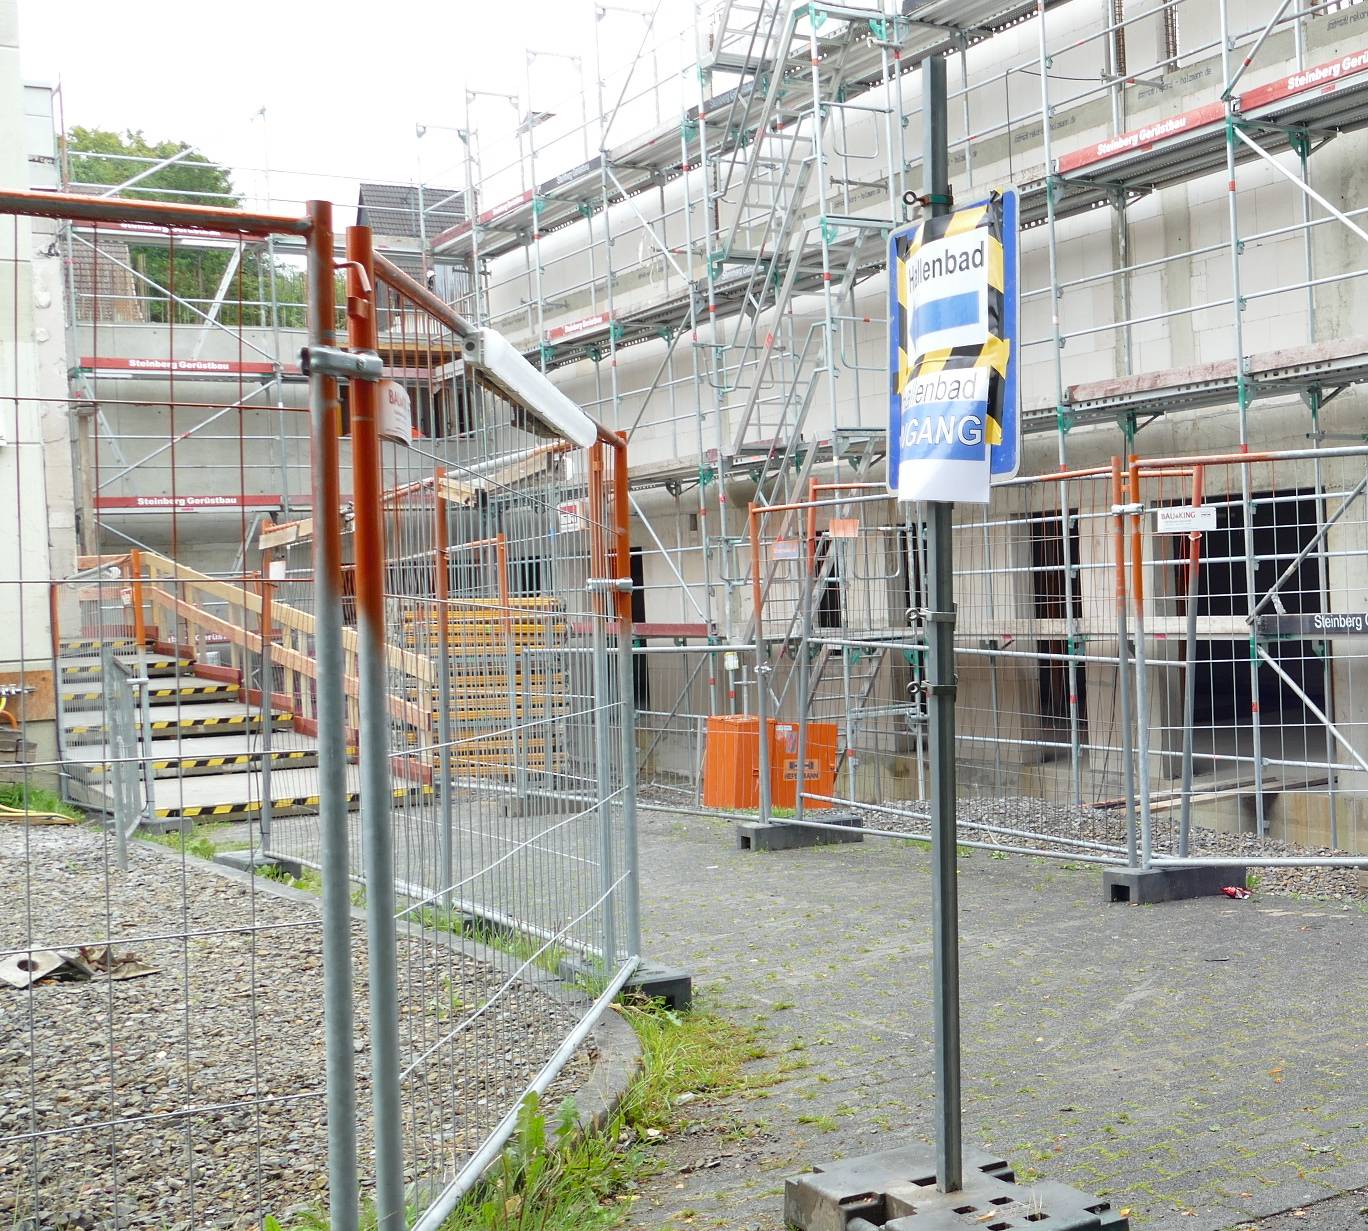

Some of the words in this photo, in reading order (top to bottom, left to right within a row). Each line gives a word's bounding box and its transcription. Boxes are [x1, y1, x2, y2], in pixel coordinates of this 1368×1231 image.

[1287, 63, 1341, 90] Steinberg
[909, 240, 985, 294] Hallenbad
[128, 359, 178, 370] Steinberg
[178, 360, 230, 370] Gerüstbau
[903, 372, 977, 409] allenbad
[137, 497, 186, 506] Steinberg
[186, 496, 237, 505] Gerüstbau
[1314, 614, 1363, 631] Steinberg
